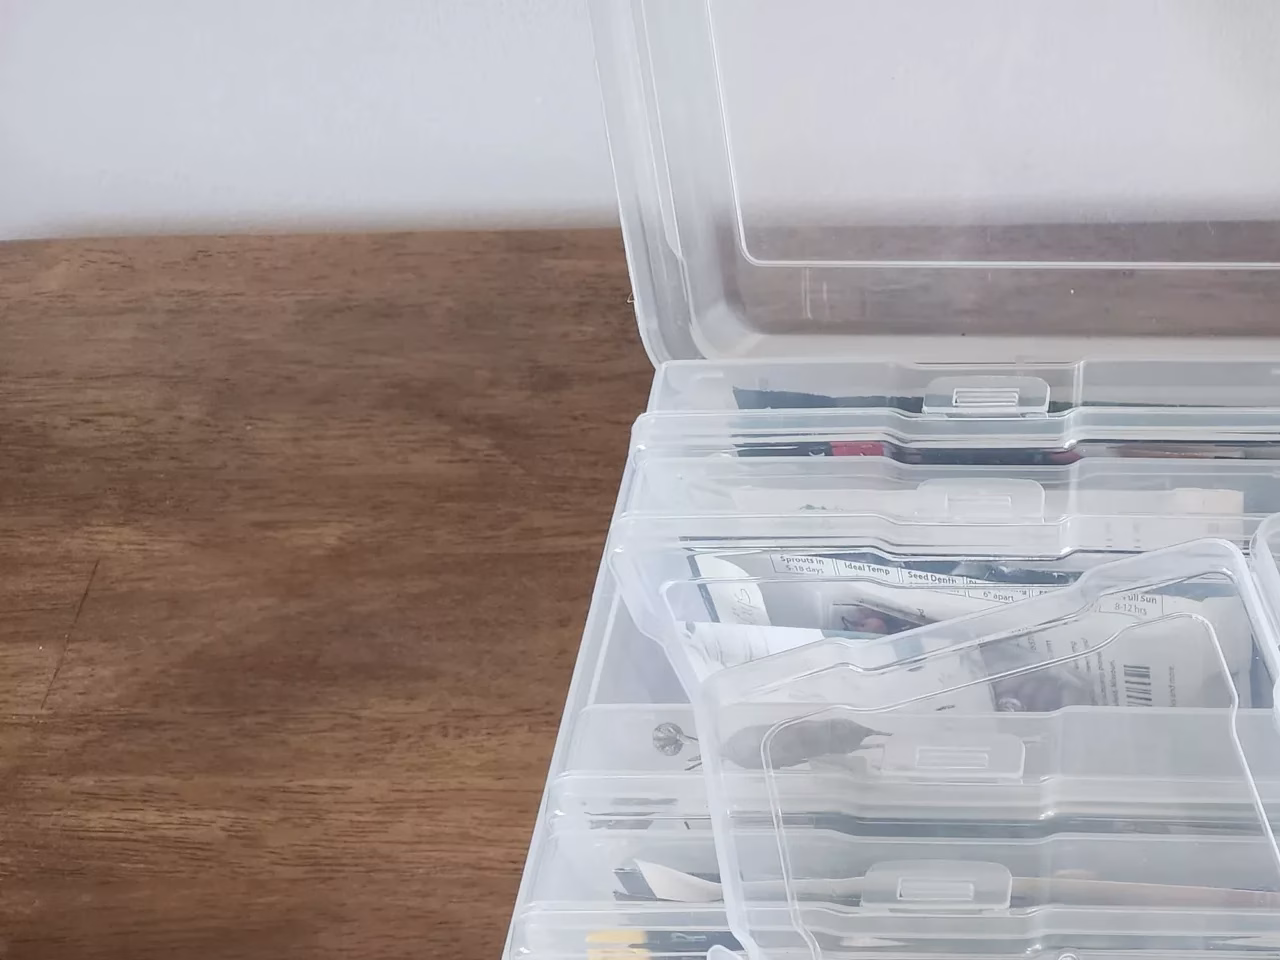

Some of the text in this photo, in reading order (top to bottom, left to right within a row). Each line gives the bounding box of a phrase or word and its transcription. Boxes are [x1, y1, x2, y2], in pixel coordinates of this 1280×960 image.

[844, 562, 890, 576] Ideal Temp
[908, 571, 929, 581] Seed
[993, 593, 1015, 602] apart
[1140, 595, 1157, 604] Sun
